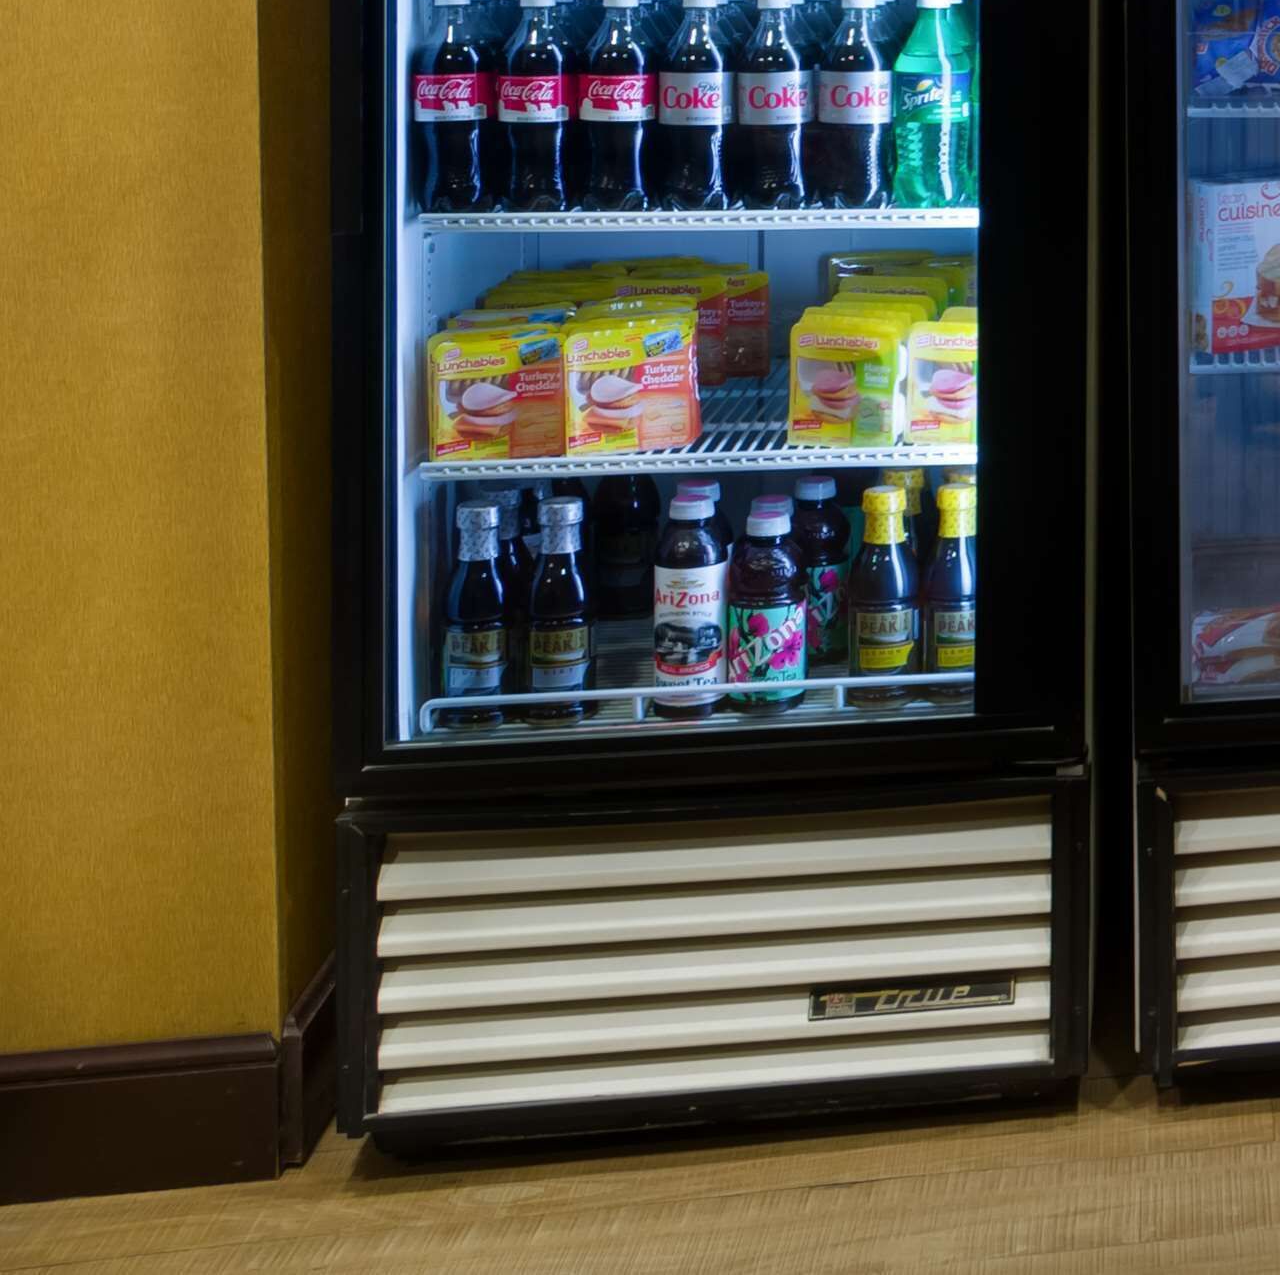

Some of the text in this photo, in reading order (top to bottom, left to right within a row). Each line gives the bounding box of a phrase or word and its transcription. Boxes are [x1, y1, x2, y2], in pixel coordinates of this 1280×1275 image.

[663, 85, 720, 109] Coke
[748, 84, 808, 109] Coke
[830, 83, 889, 109] Coke
[435, 355, 506, 373] Lunchables
[566, 348, 632, 365] Lunchables
[641, 374, 685, 385] Cheddar
[654, 588, 720, 609] AriZona
[860, 620, 897, 634] PEAK
